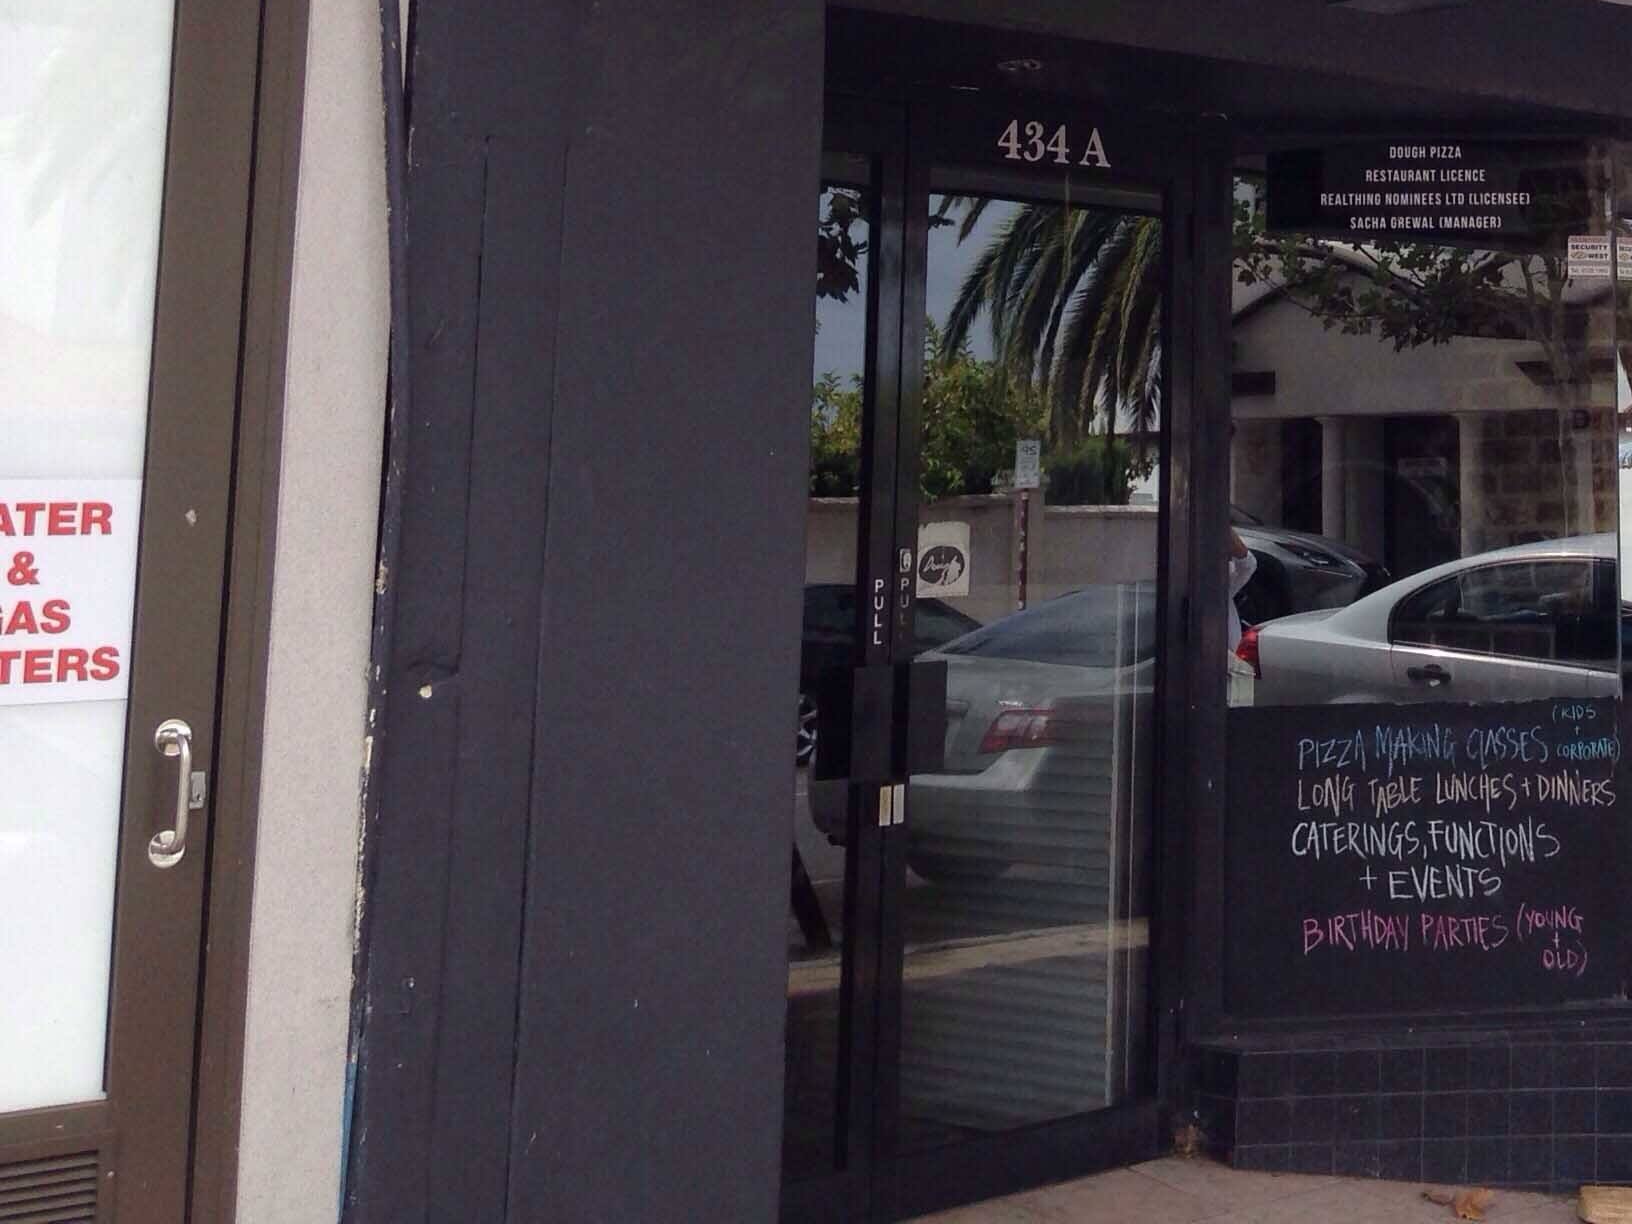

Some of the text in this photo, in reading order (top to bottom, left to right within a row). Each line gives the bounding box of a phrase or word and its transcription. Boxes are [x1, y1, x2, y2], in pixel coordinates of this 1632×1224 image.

[997, 119, 1111, 168] 434 A
[1389, 146, 1462, 159] DOUGH PIZZA
[1366, 169, 1486, 182] RESTAURANT LICENCE
[1321, 193, 1381, 206] REALTHING
[1385, 193, 1442, 206] NOMINEES
[1446, 193, 1465, 206] LTD
[1350, 216, 1386, 230] SACHA
[1391, 216, 1435, 229] GREWAL
[7, 551, 40, 586] &
[0, 599, 71, 635] AS
[873, 579, 884, 645] PULL
[1298, 724, 1548, 774] PIZZA MAKING CLASSES
[1298, 776, 1354, 818] LONG
[1370, 776, 1423, 818] TABLE
[1436, 775, 1518, 813] LUNCHES
[1537, 771, 1616, 814] DINNERS
[1388, 865, 1502, 903] EVENTS
[1303, 910, 1409, 955] BIRTHDAY
[1422, 910, 1508, 952] PARTIES
